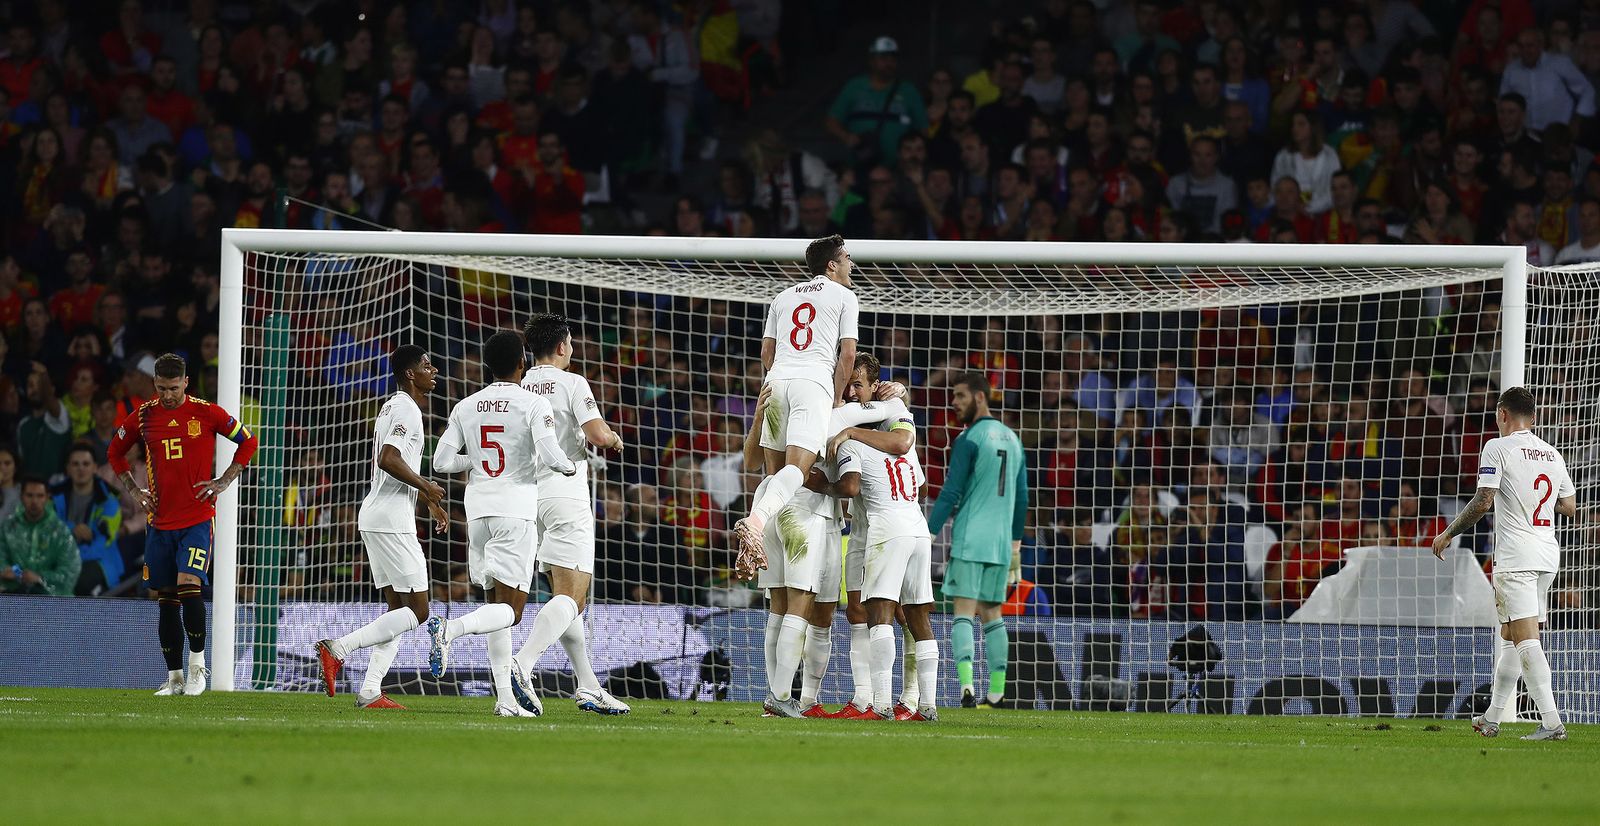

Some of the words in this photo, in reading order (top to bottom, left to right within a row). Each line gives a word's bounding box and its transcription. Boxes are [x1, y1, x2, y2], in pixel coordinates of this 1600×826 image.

[795, 282, 825, 293] WINKS
[790, 302, 816, 351] 8
[522, 382, 556, 395] AGUIRE
[477, 400, 509, 413] GOMEZ
[162, 438, 183, 460] 15
[480, 425, 506, 477] 5
[884, 457, 917, 502] 10
[997, 449, 1007, 496] 1
[1533, 474, 1553, 526] 2
[187, 546, 207, 571] 15
